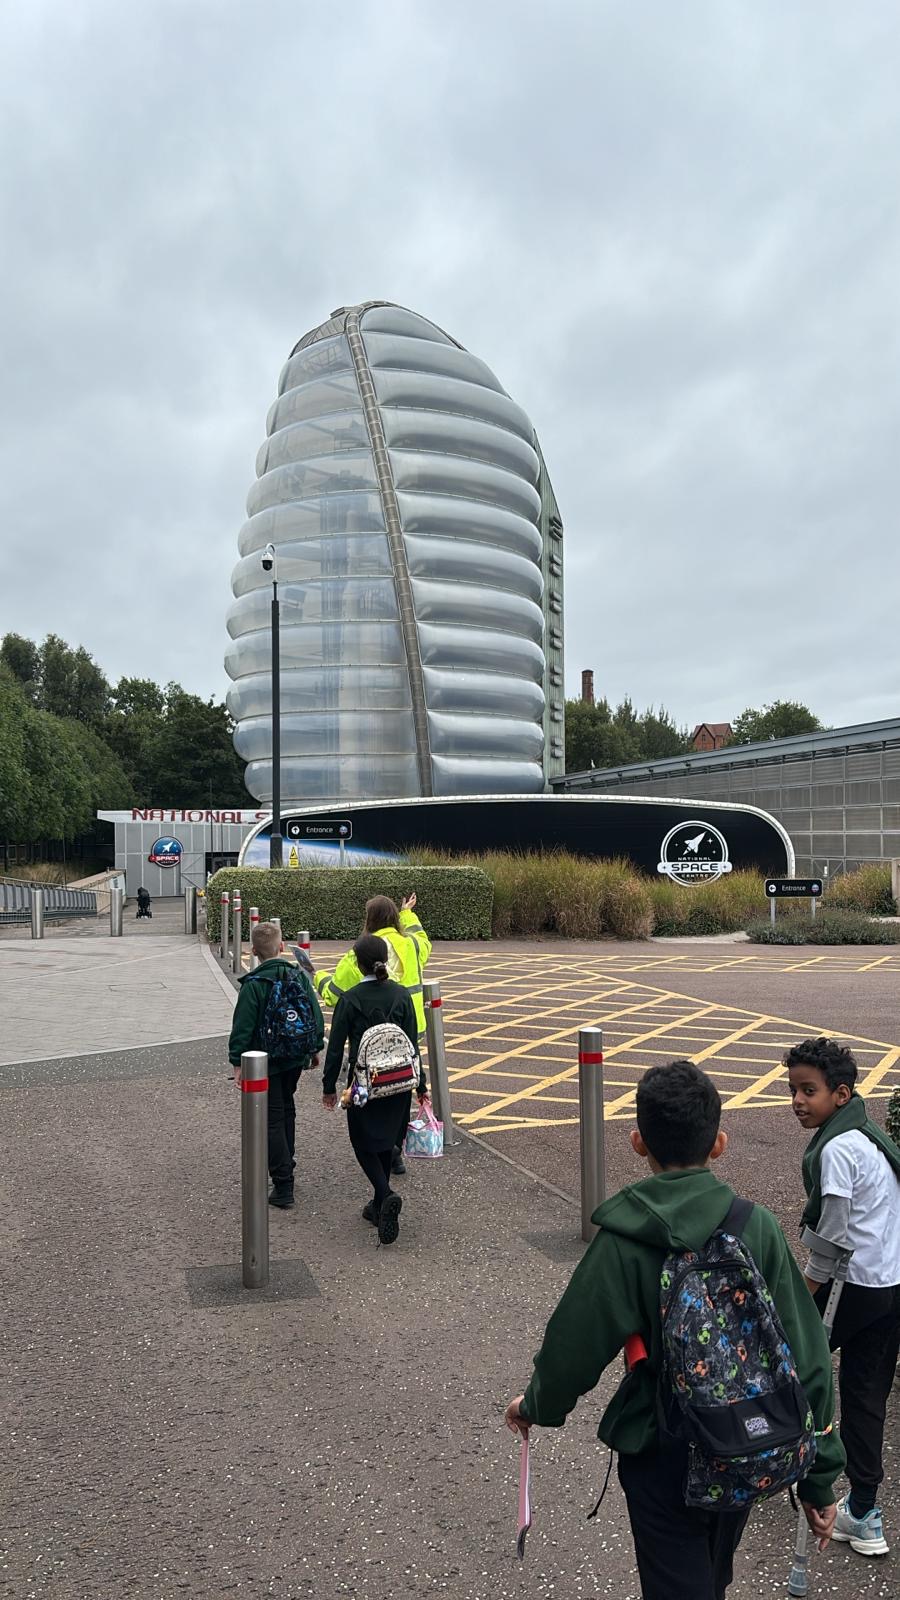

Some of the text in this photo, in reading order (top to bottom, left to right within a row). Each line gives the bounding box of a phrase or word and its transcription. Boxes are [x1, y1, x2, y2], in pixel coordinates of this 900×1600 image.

[131, 807, 242, 824] NATIONAL
[306, 826, 334, 834] Entrance
[671, 862, 719, 872] SPACE
[781, 884, 806, 892] Entrance
